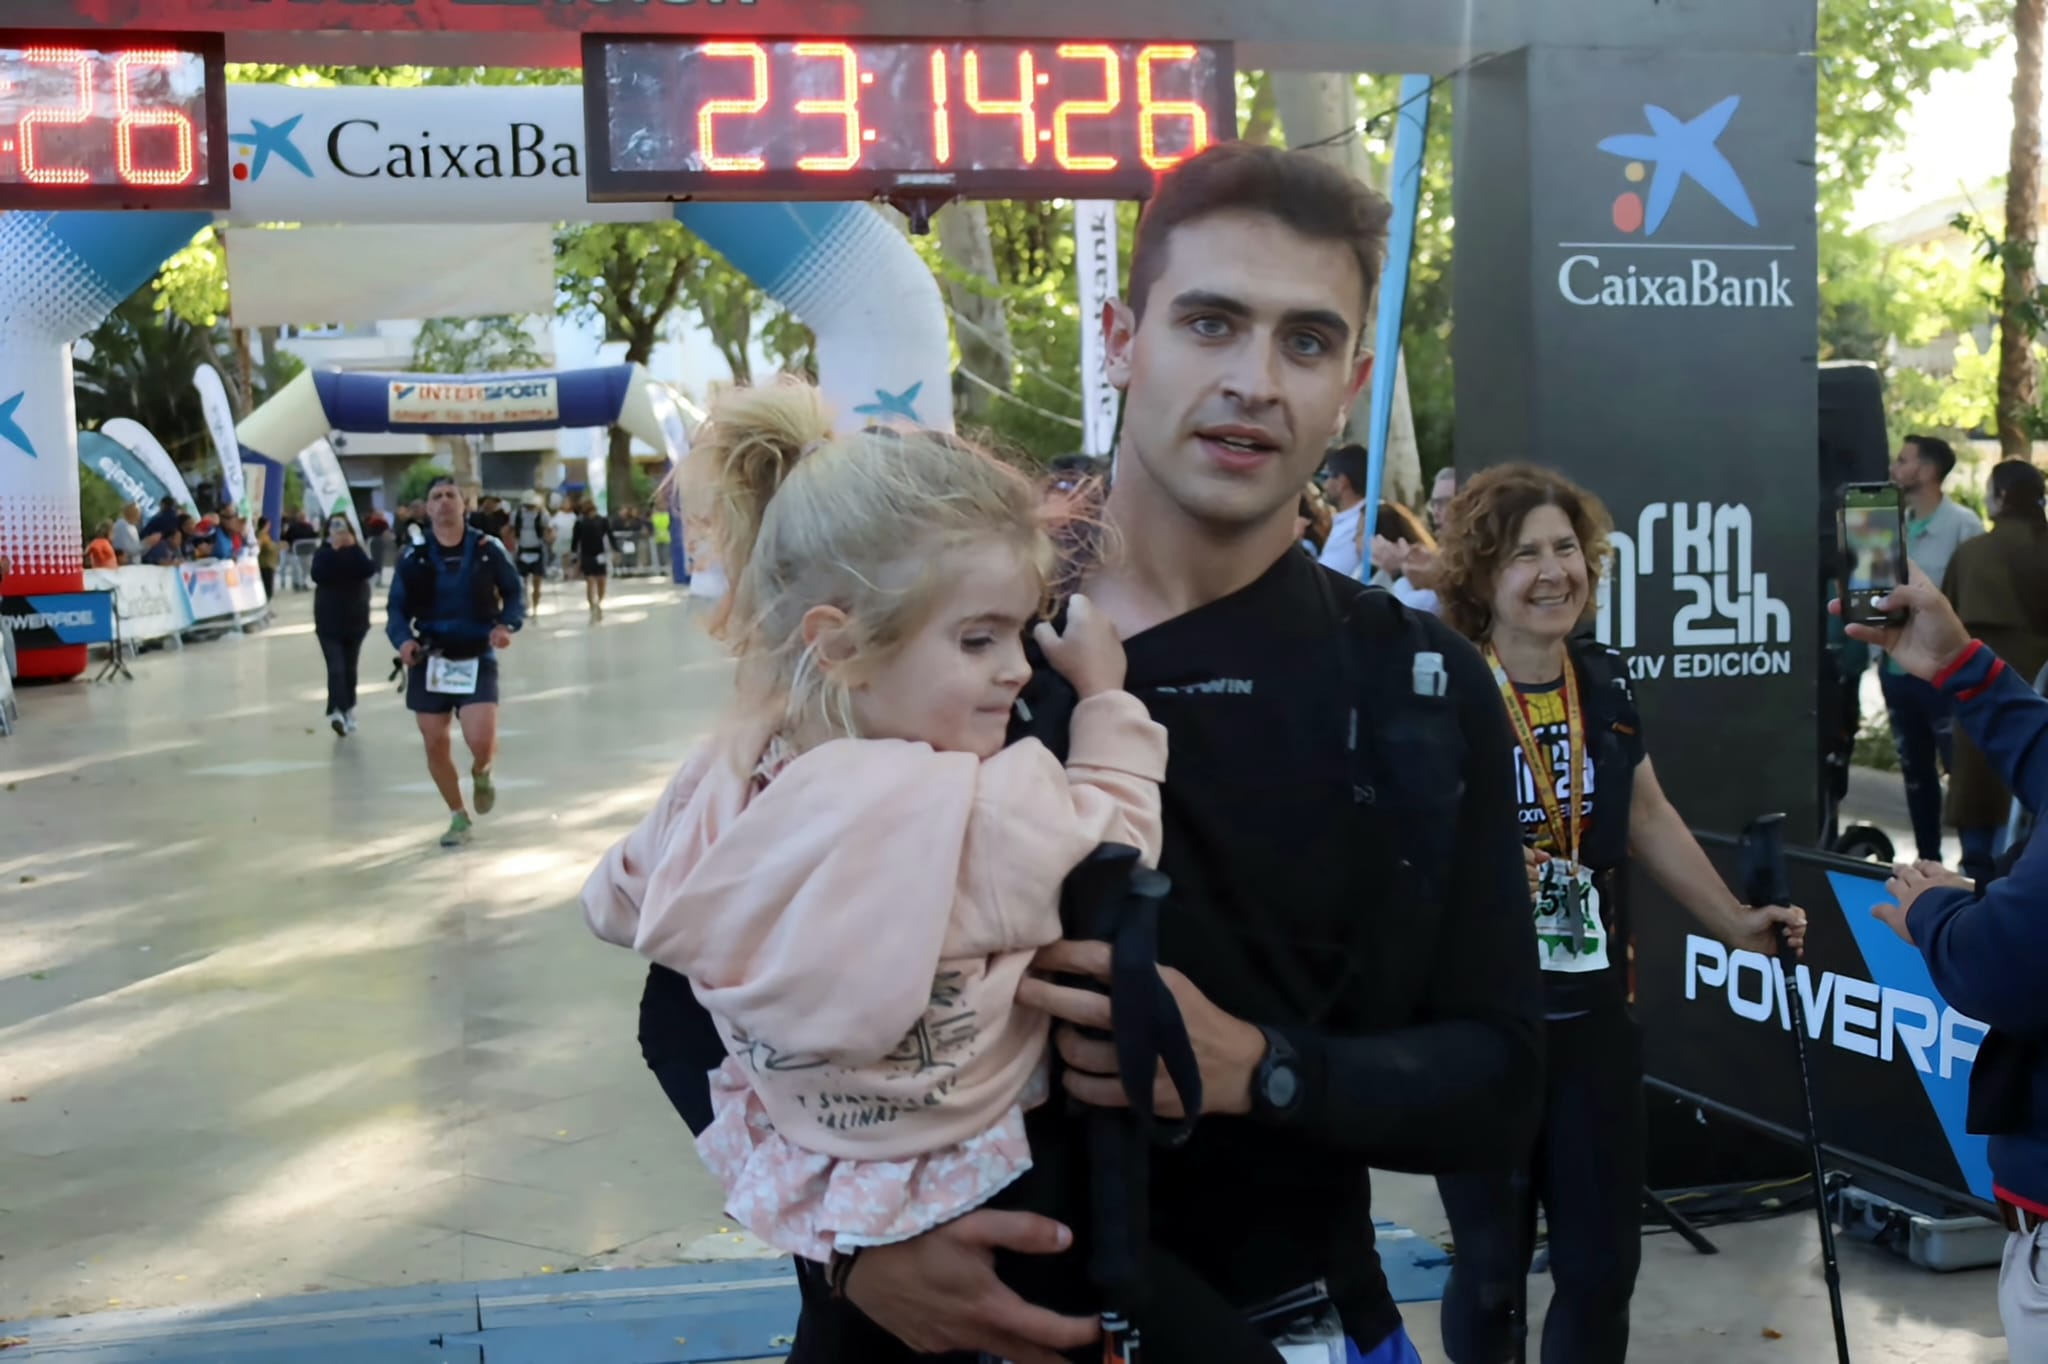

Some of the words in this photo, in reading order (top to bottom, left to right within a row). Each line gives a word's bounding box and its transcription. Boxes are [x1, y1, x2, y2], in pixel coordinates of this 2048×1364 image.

[698, 42, 1209, 171] 23:14:26
[1558, 254, 1794, 307] CaixaBank
[1673, 645, 1791, 678] EDICIÓN
